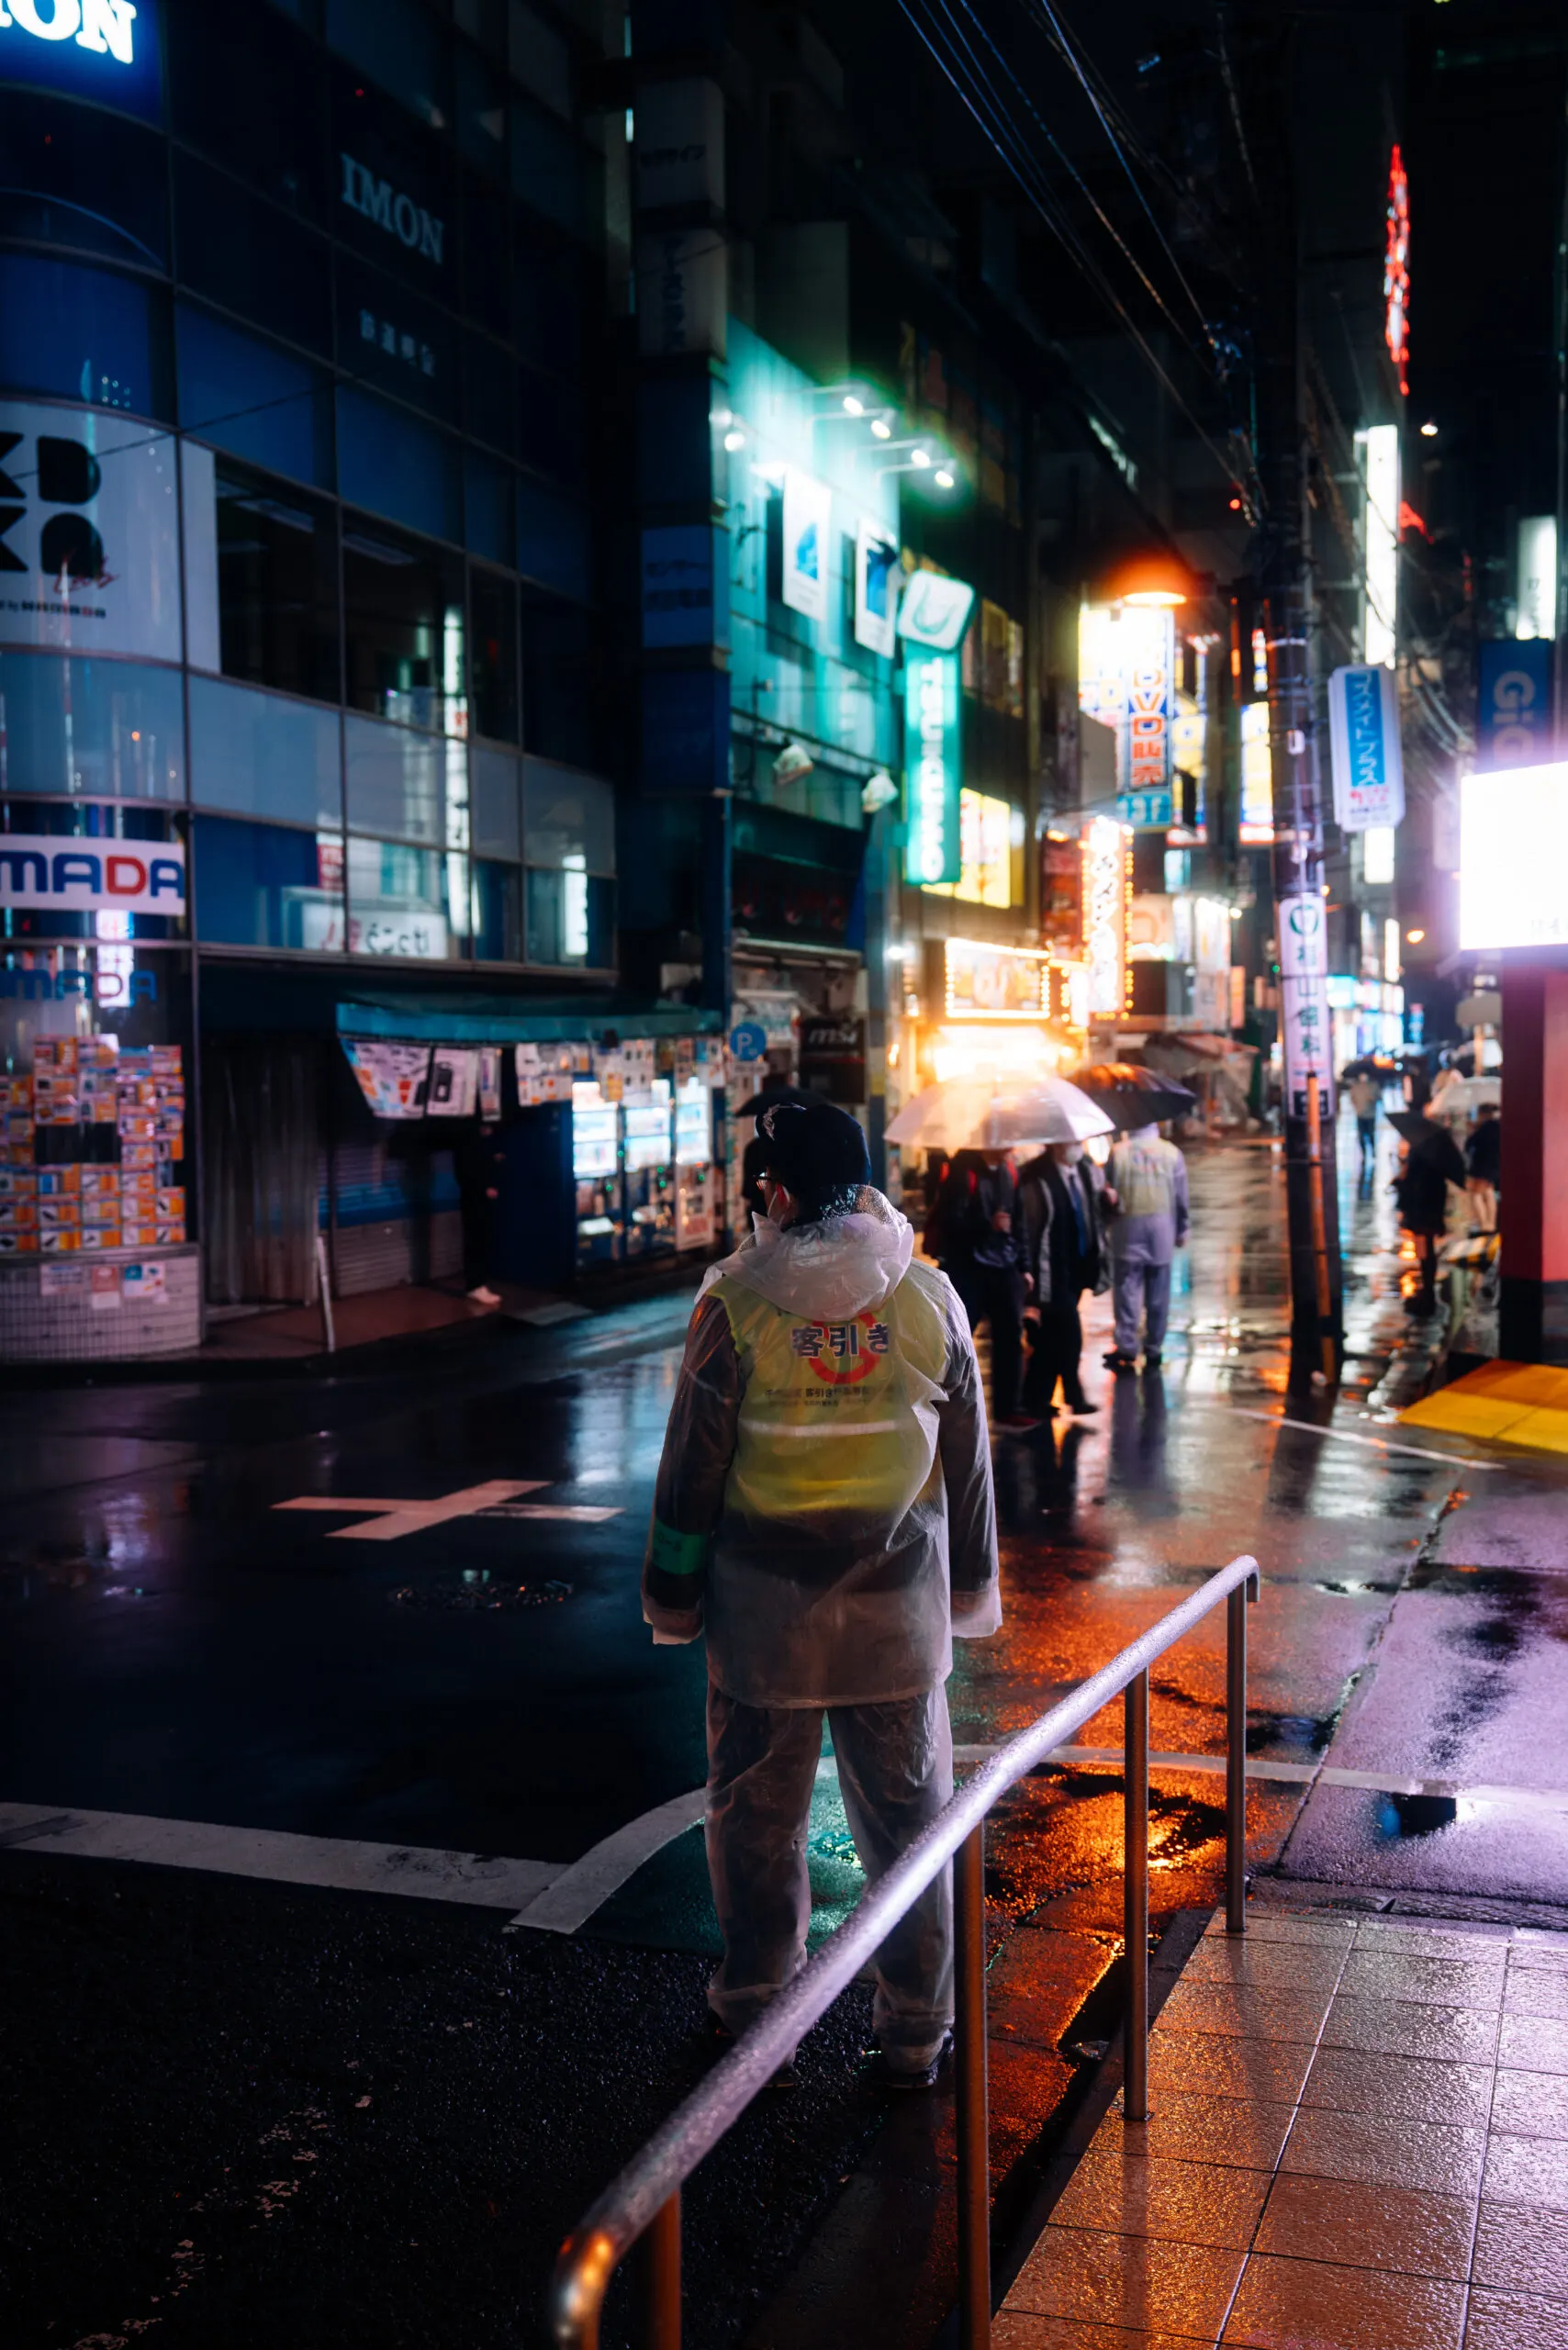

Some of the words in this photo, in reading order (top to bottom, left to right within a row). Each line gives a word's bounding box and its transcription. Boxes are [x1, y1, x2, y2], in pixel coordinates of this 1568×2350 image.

[0, 0, 136, 64] ON
[340, 151, 444, 266] IMON
[737, 1032, 753, 1056] P
[790, 1322, 890, 1359] 客引き
